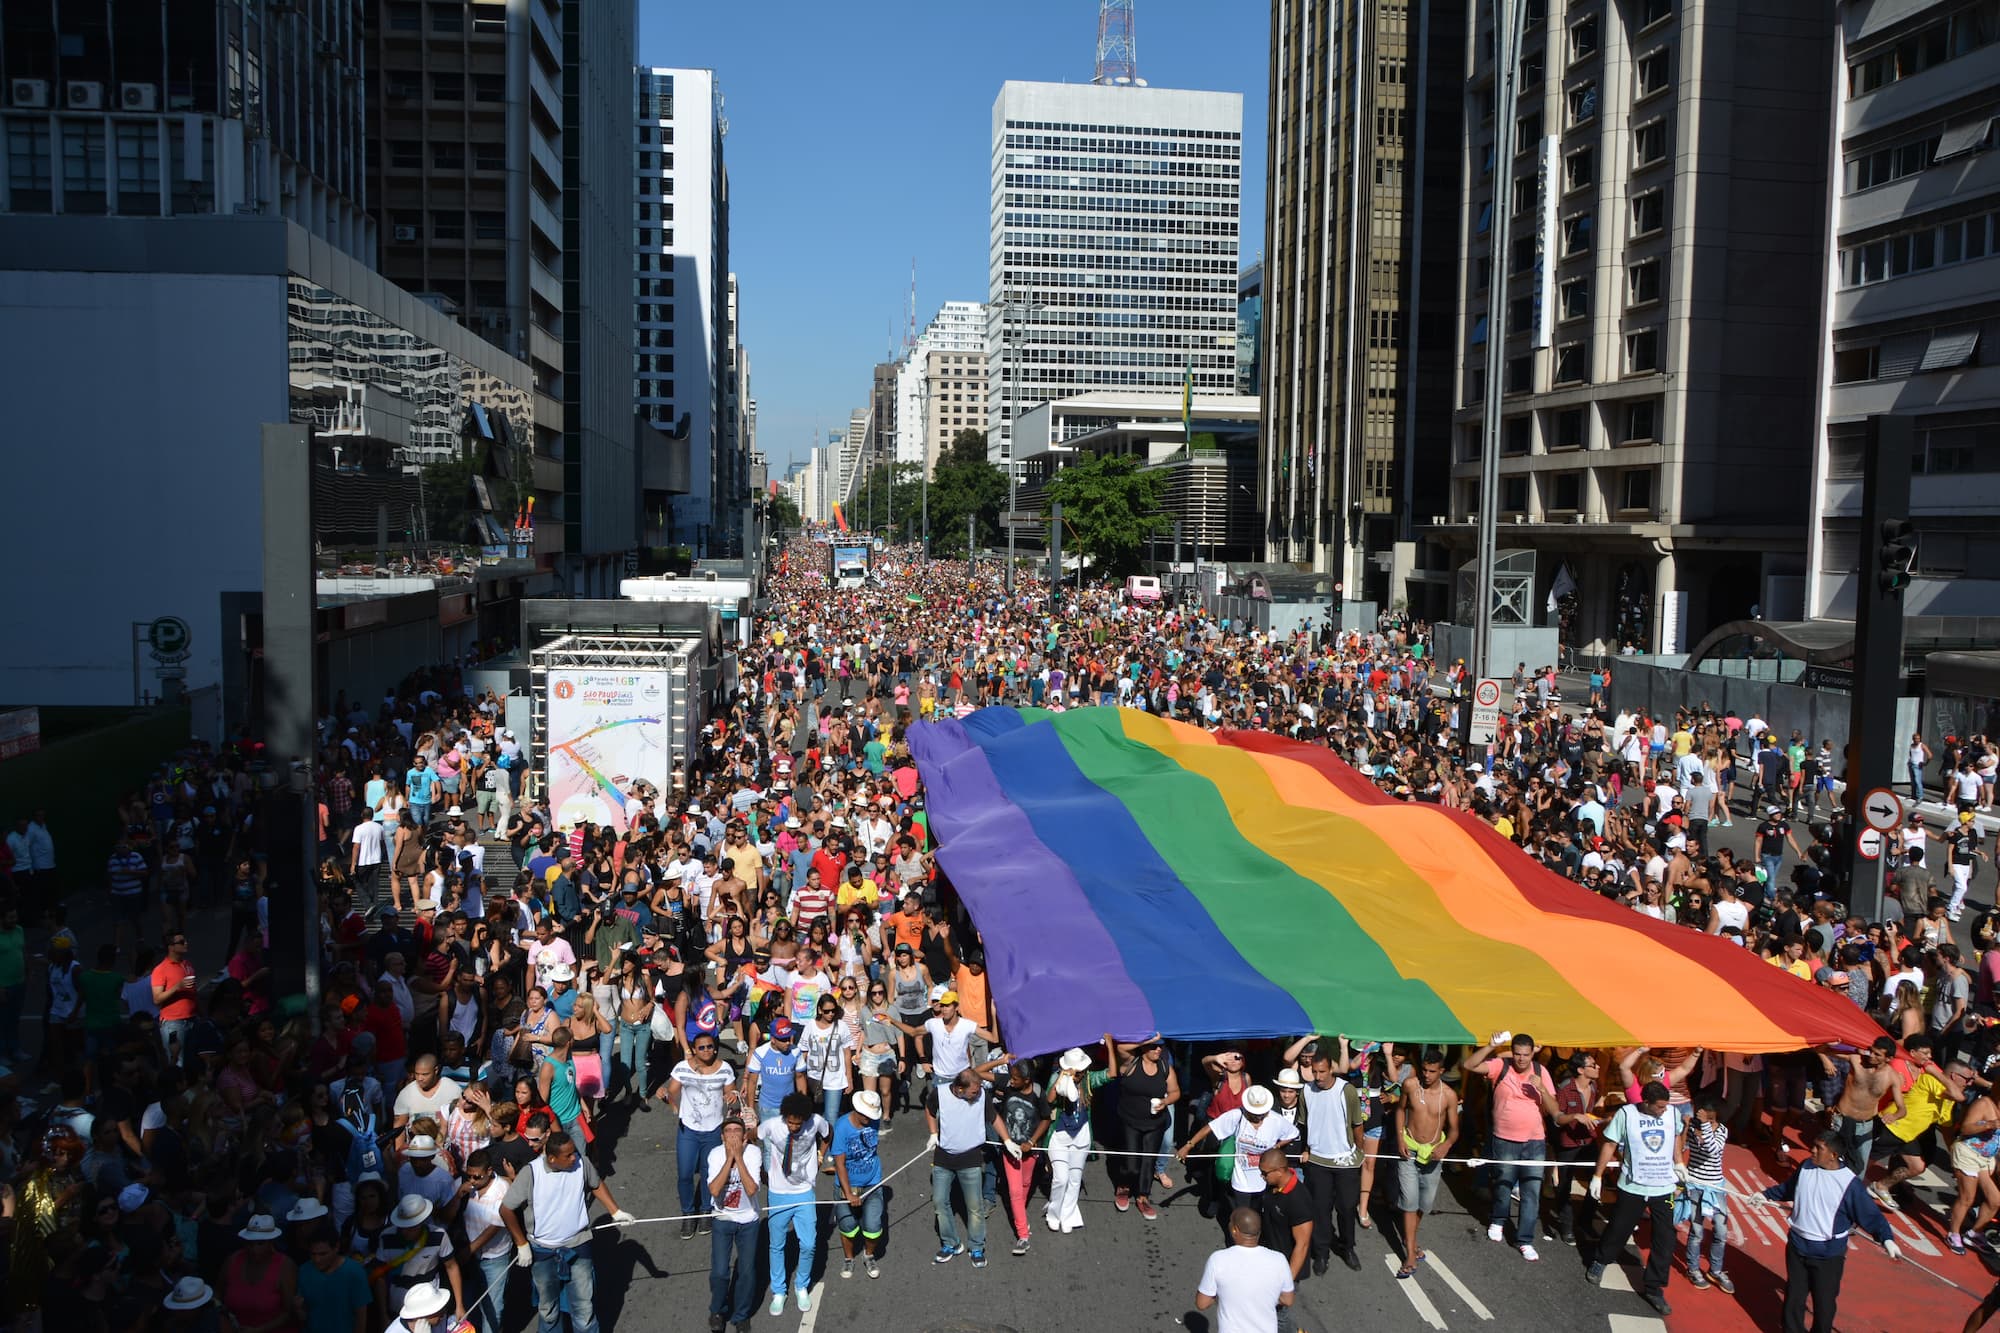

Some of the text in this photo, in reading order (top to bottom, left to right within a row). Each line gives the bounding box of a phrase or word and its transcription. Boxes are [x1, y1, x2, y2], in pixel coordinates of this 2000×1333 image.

[615, 676, 640, 686] LGBT
[765, 1066, 792, 1075] ITALIA
[1639, 1118, 1664, 1128] PMG
